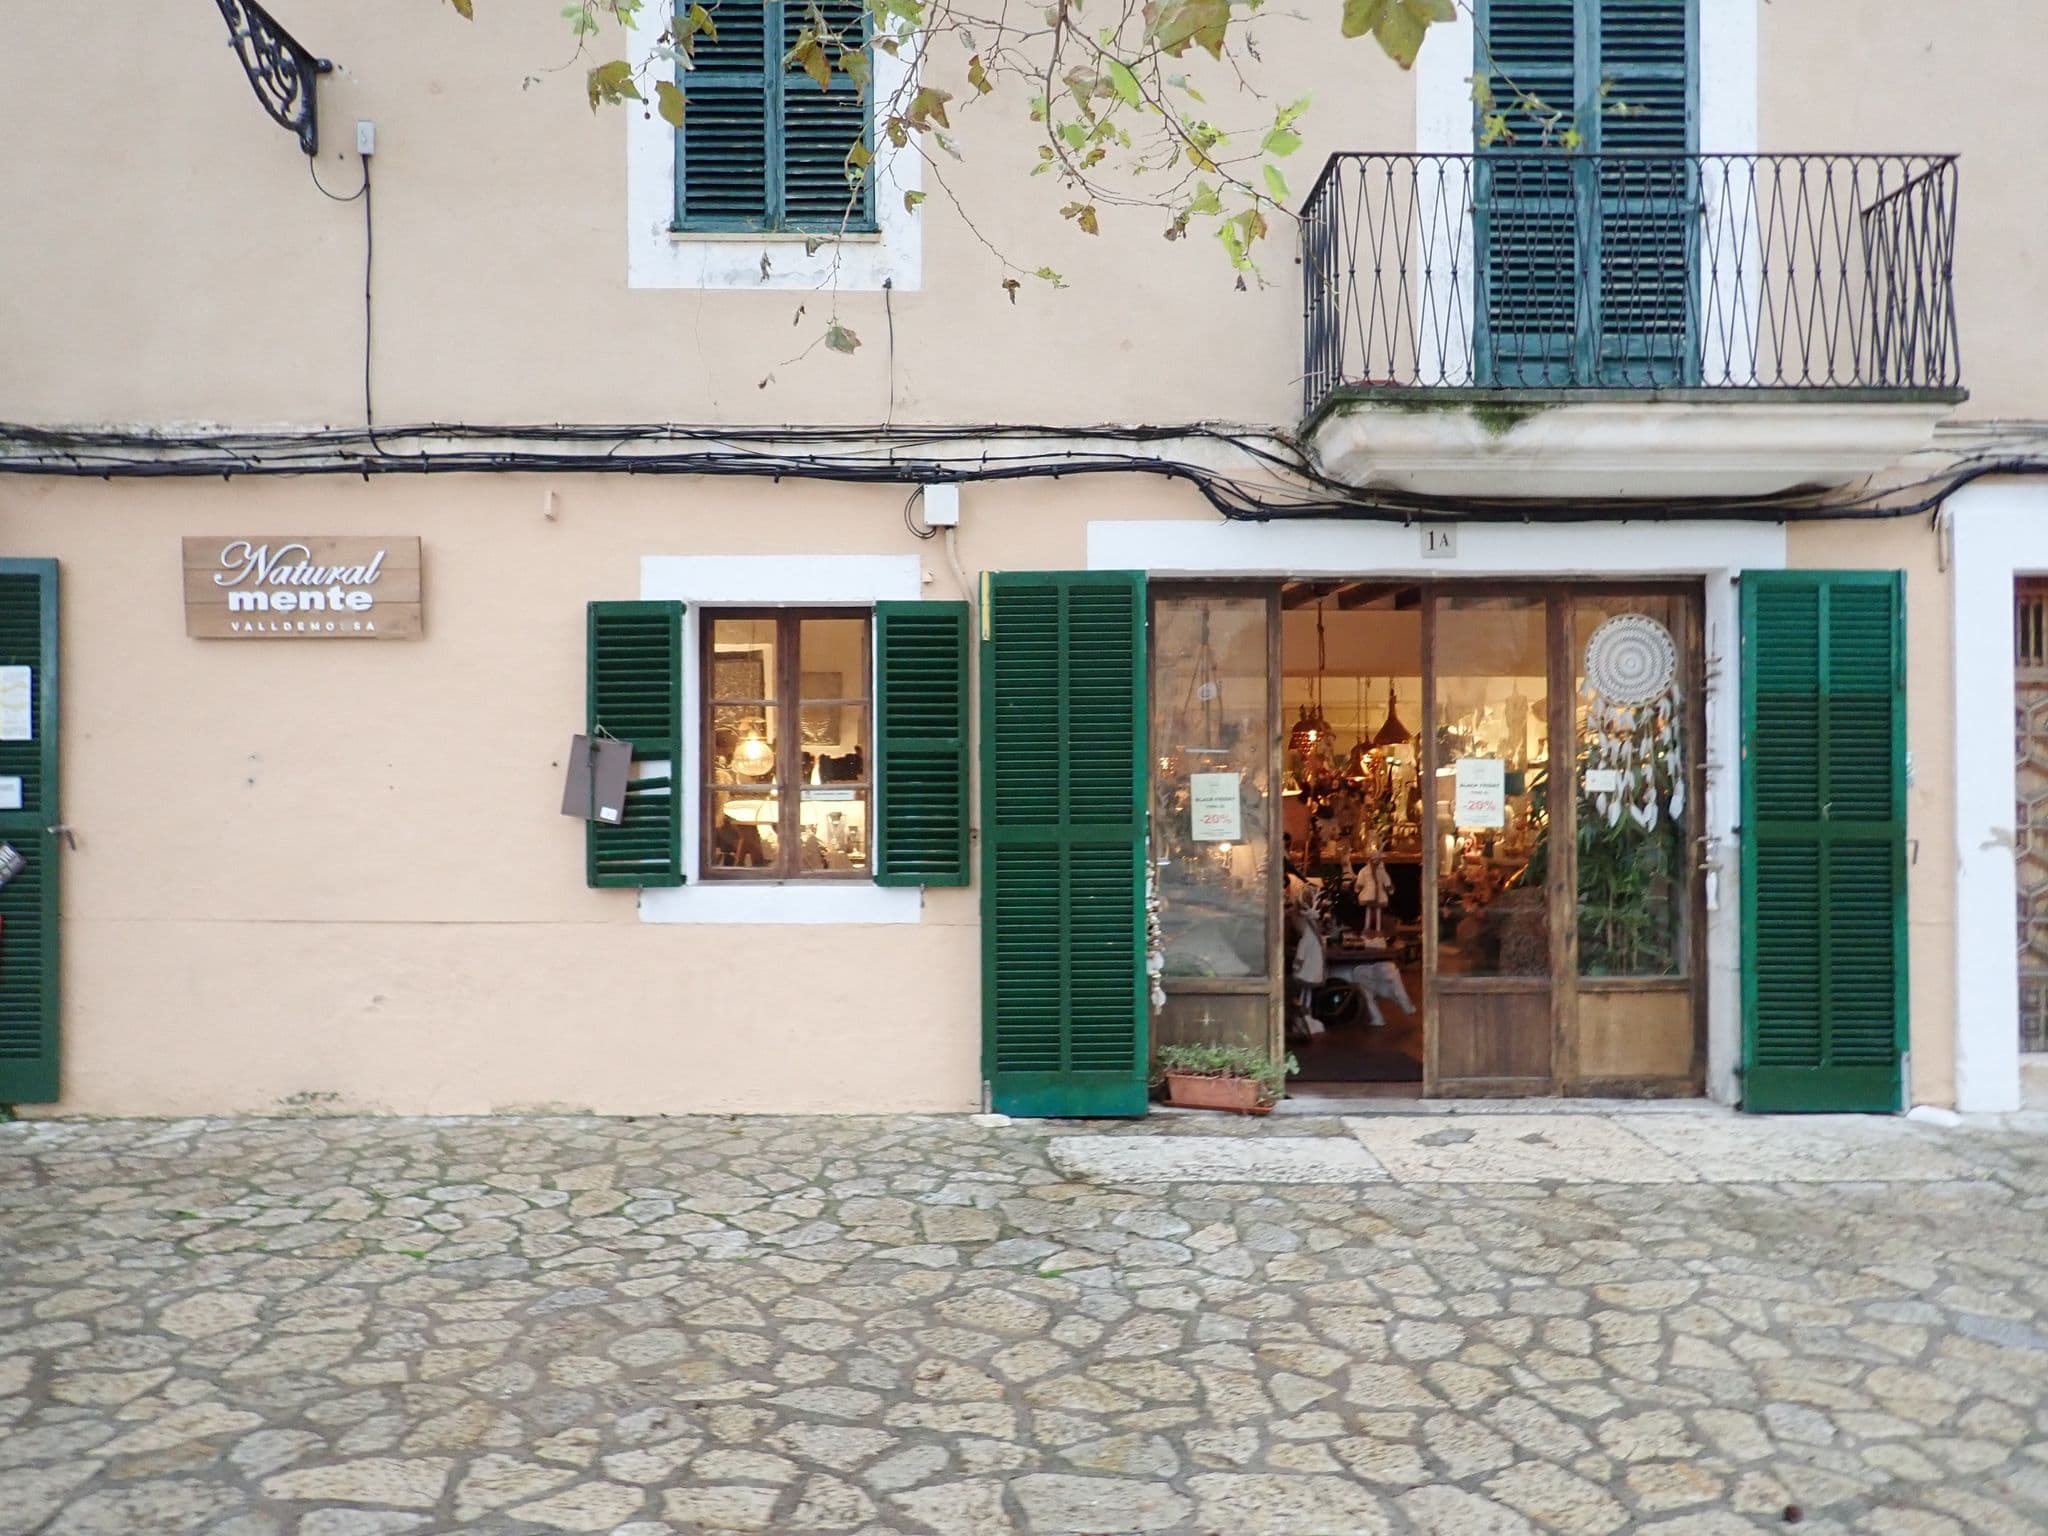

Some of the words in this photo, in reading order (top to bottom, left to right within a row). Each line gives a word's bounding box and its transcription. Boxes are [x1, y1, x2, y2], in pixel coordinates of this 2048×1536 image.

[213, 540, 386, 587] Natural
[227, 585, 374, 612] mente
[230, 621, 375, 632] VALLDEMOSA
